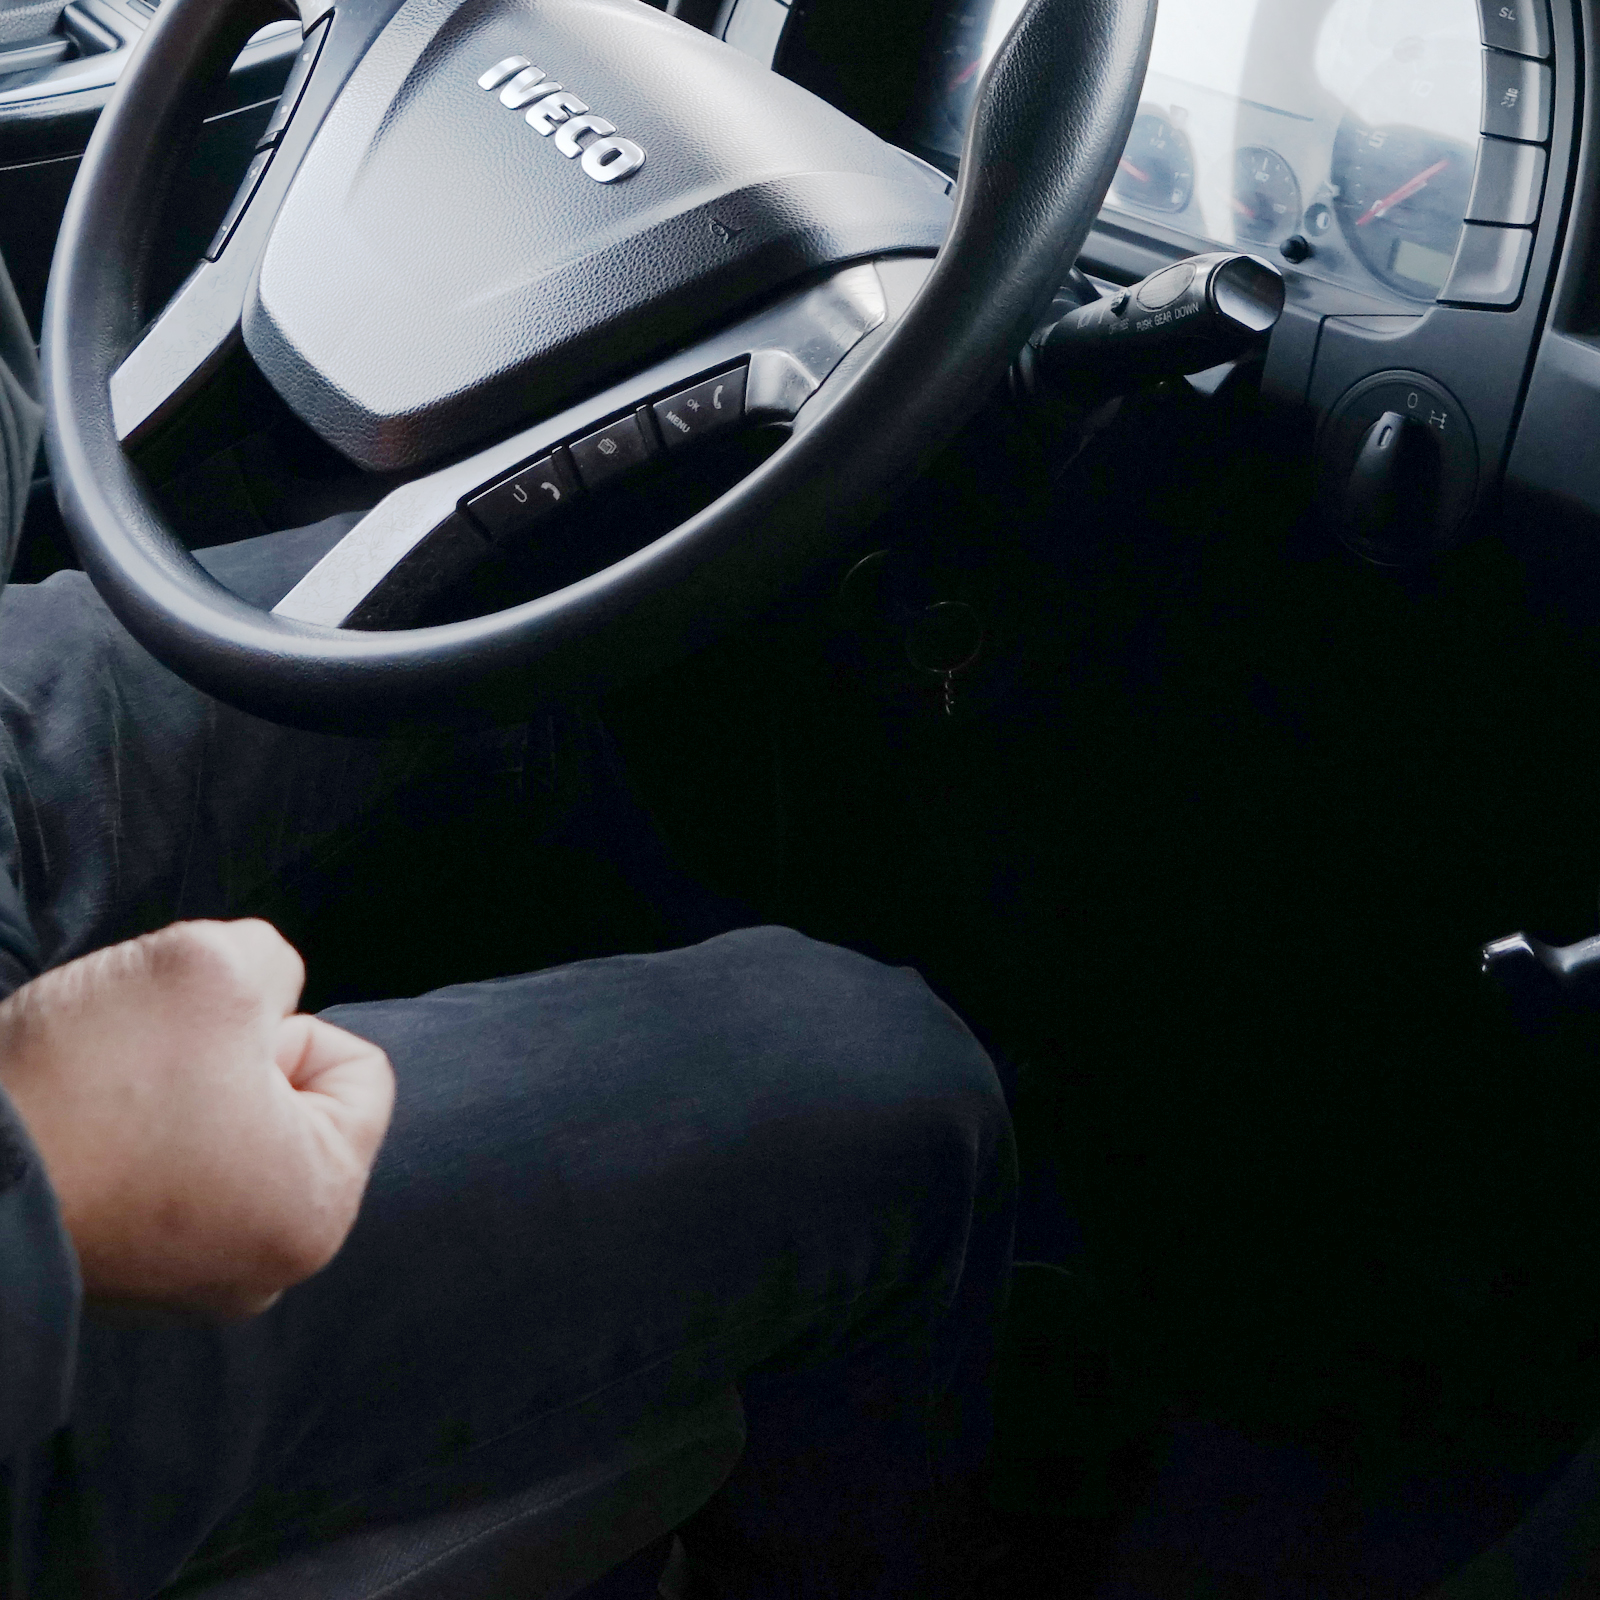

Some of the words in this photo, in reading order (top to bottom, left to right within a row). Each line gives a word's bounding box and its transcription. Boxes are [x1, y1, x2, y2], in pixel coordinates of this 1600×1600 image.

[1498, 6, 1516, 21] SL
[476, 54, 648, 185] IVECO
[1154, 310, 1173, 329] GEAR
[1174, 302, 1200, 320] DOWN
[686, 398, 701, 413] OK
[665, 410, 691, 434] MENU
